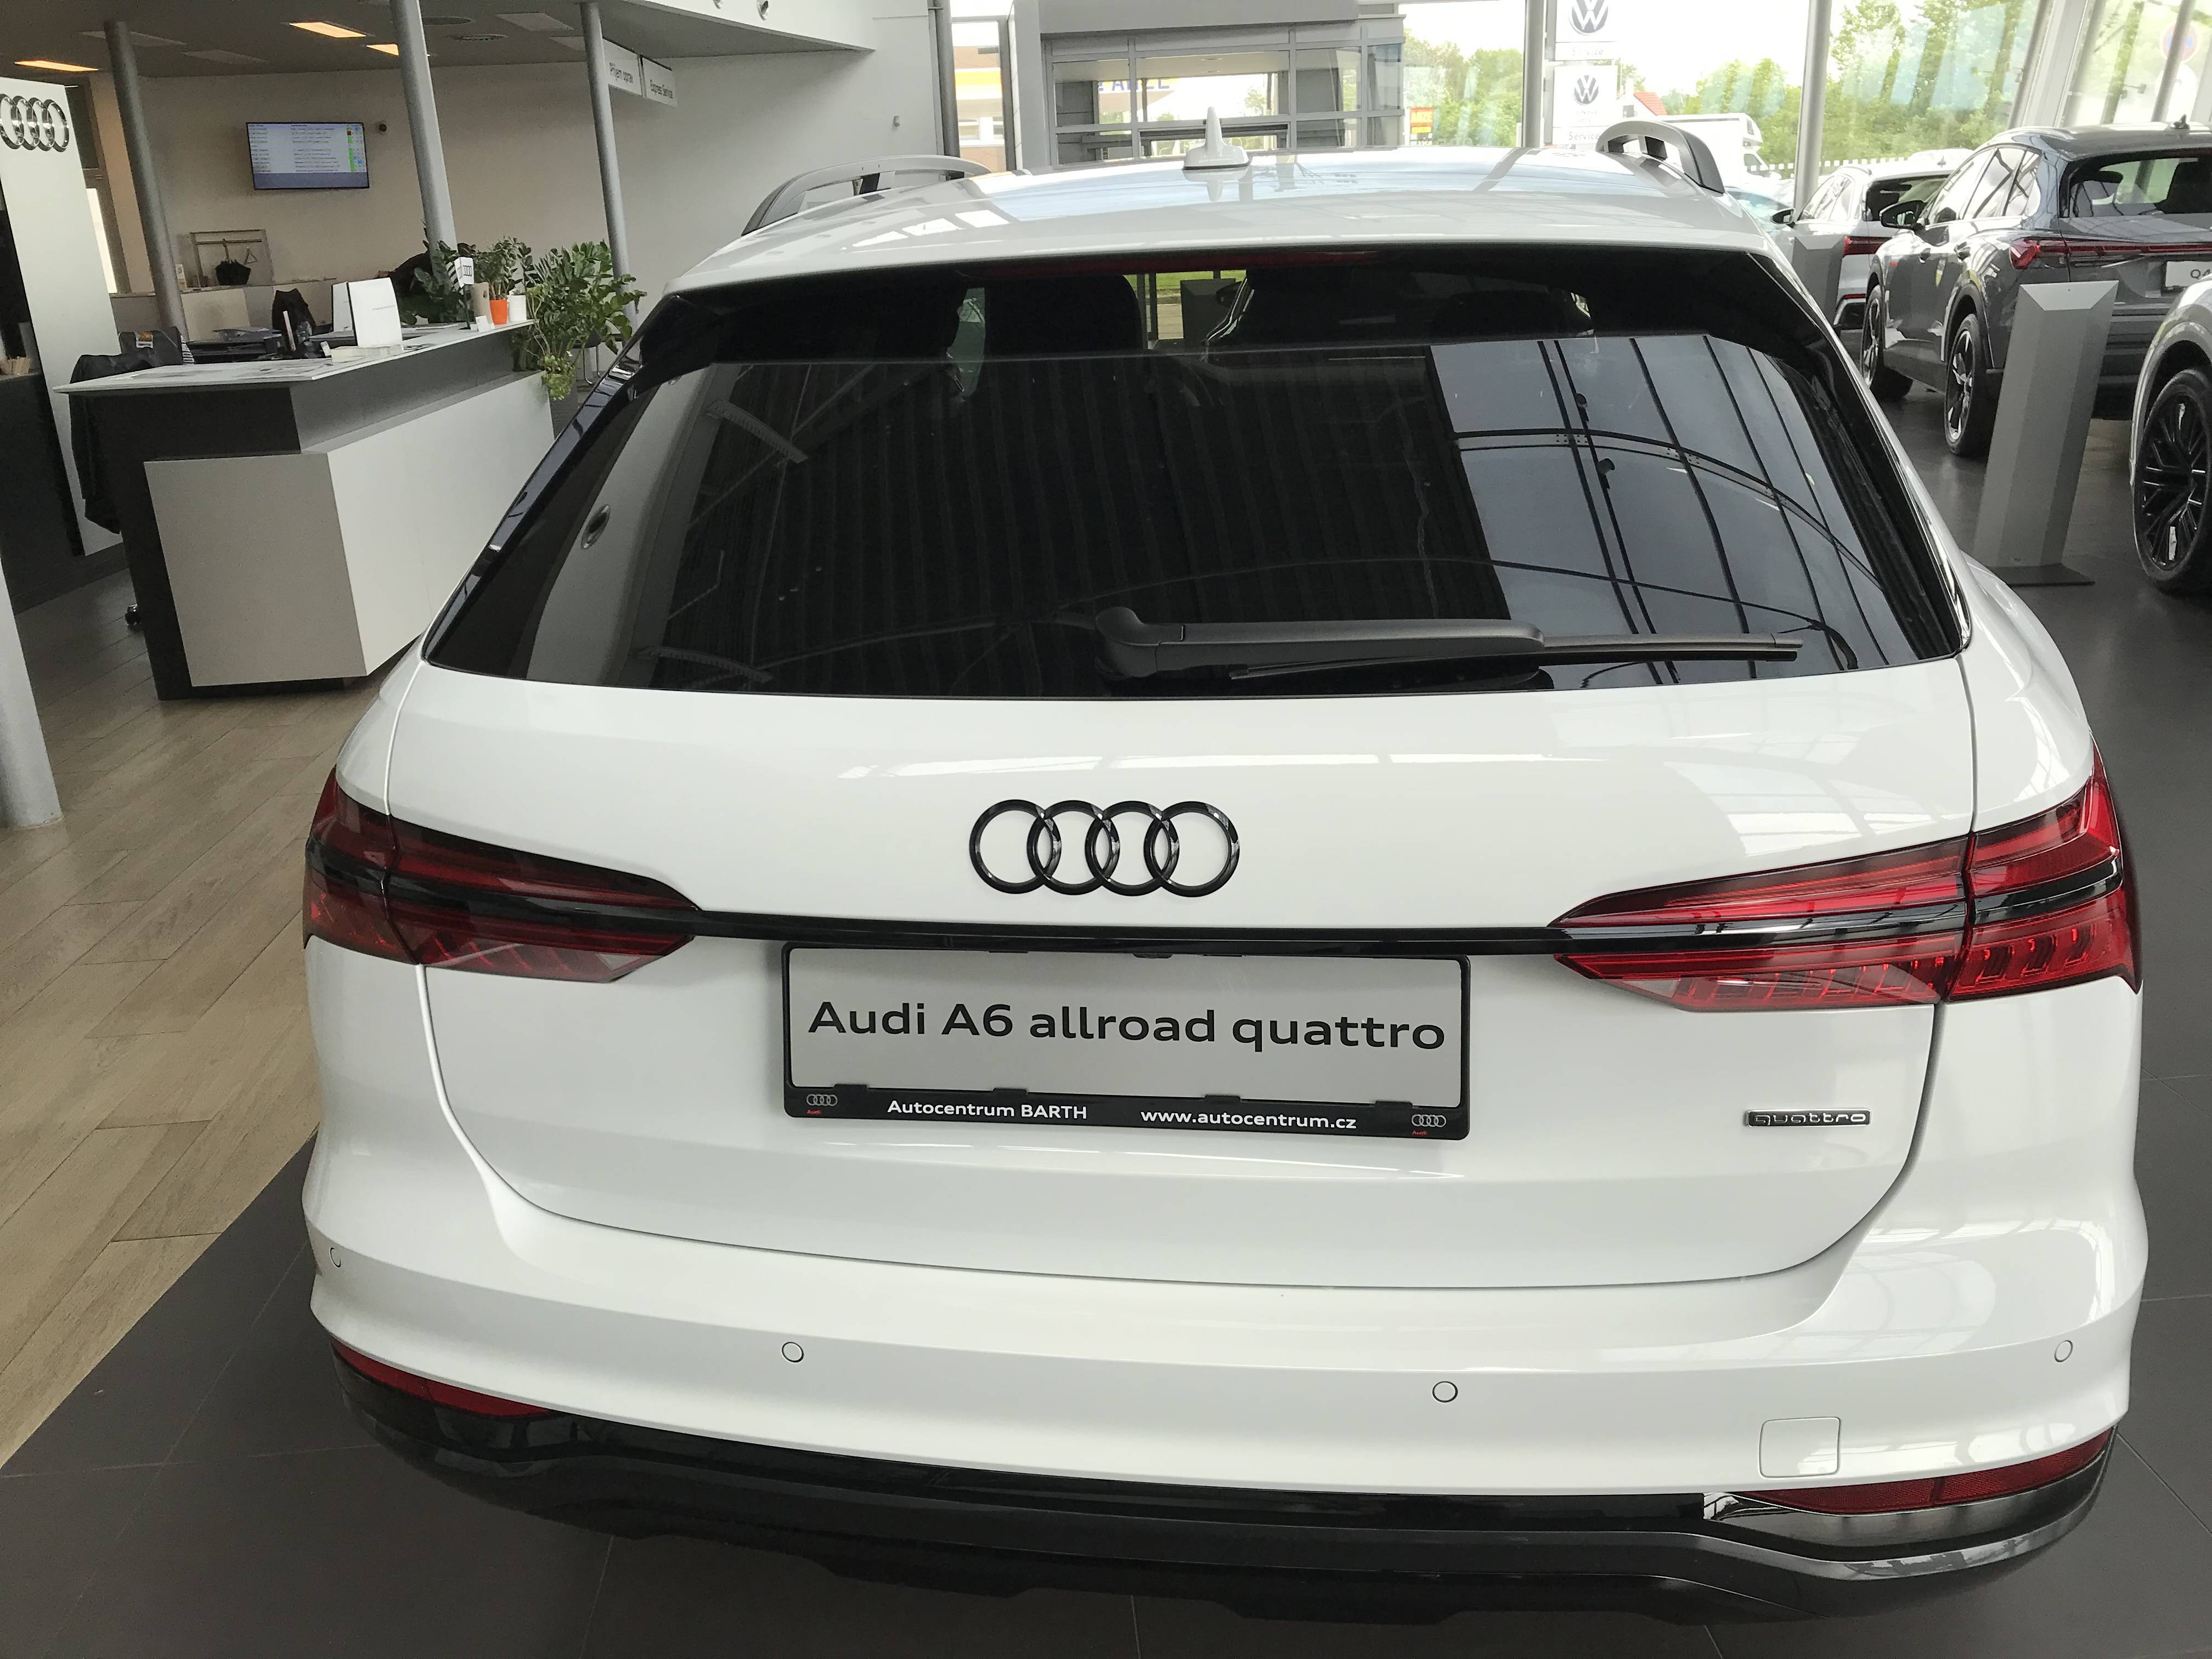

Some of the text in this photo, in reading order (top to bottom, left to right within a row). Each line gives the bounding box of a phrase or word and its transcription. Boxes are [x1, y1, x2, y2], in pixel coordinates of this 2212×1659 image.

[1572, 47, 1604, 55] Srvice
[1568, 131, 1600, 140] Service
[808, 1002, 1444, 1052] Audi A6 allroad quattro
[887, 1100, 1357, 1129] Autocentrum BARTH www.autocentrum.cz
[1755, 1113, 1866, 1126] quattro
